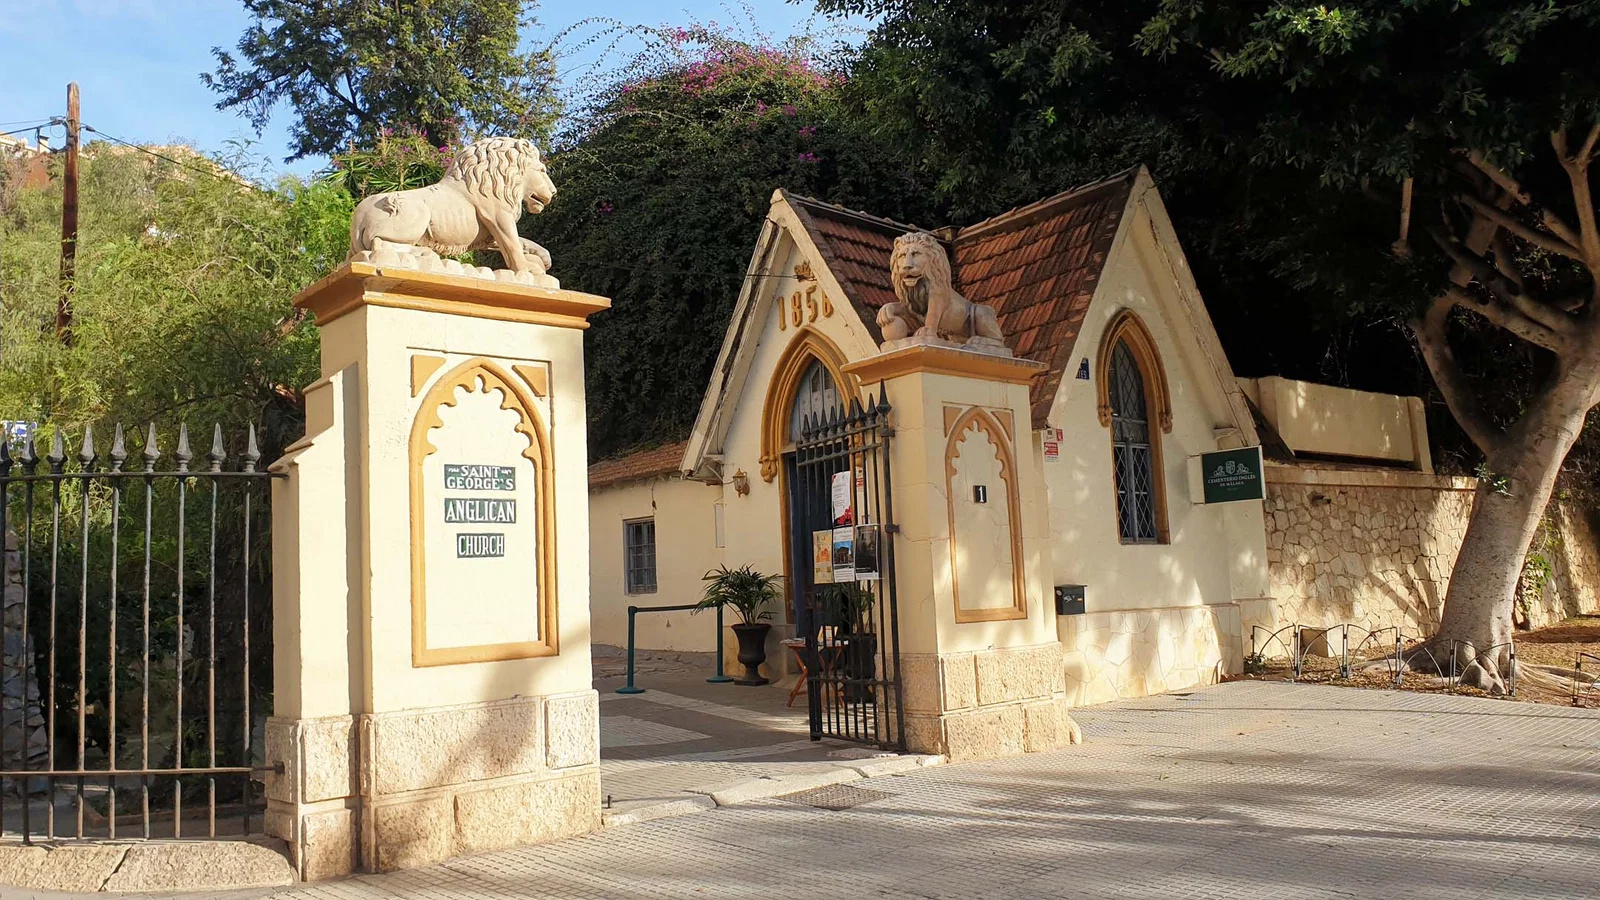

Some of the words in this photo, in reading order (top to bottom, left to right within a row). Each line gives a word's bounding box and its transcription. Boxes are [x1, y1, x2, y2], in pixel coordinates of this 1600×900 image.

[777, 285, 834, 331] 1856
[461, 465, 501, 478] SAINT
[1207, 476, 1238, 484] CEMENTERIO
[446, 476, 514, 490] GEORGE'S
[978, 486, 984, 503] 1
[446, 500, 515, 522] ANGLICAN
[458, 535, 504, 556] CHURCH
